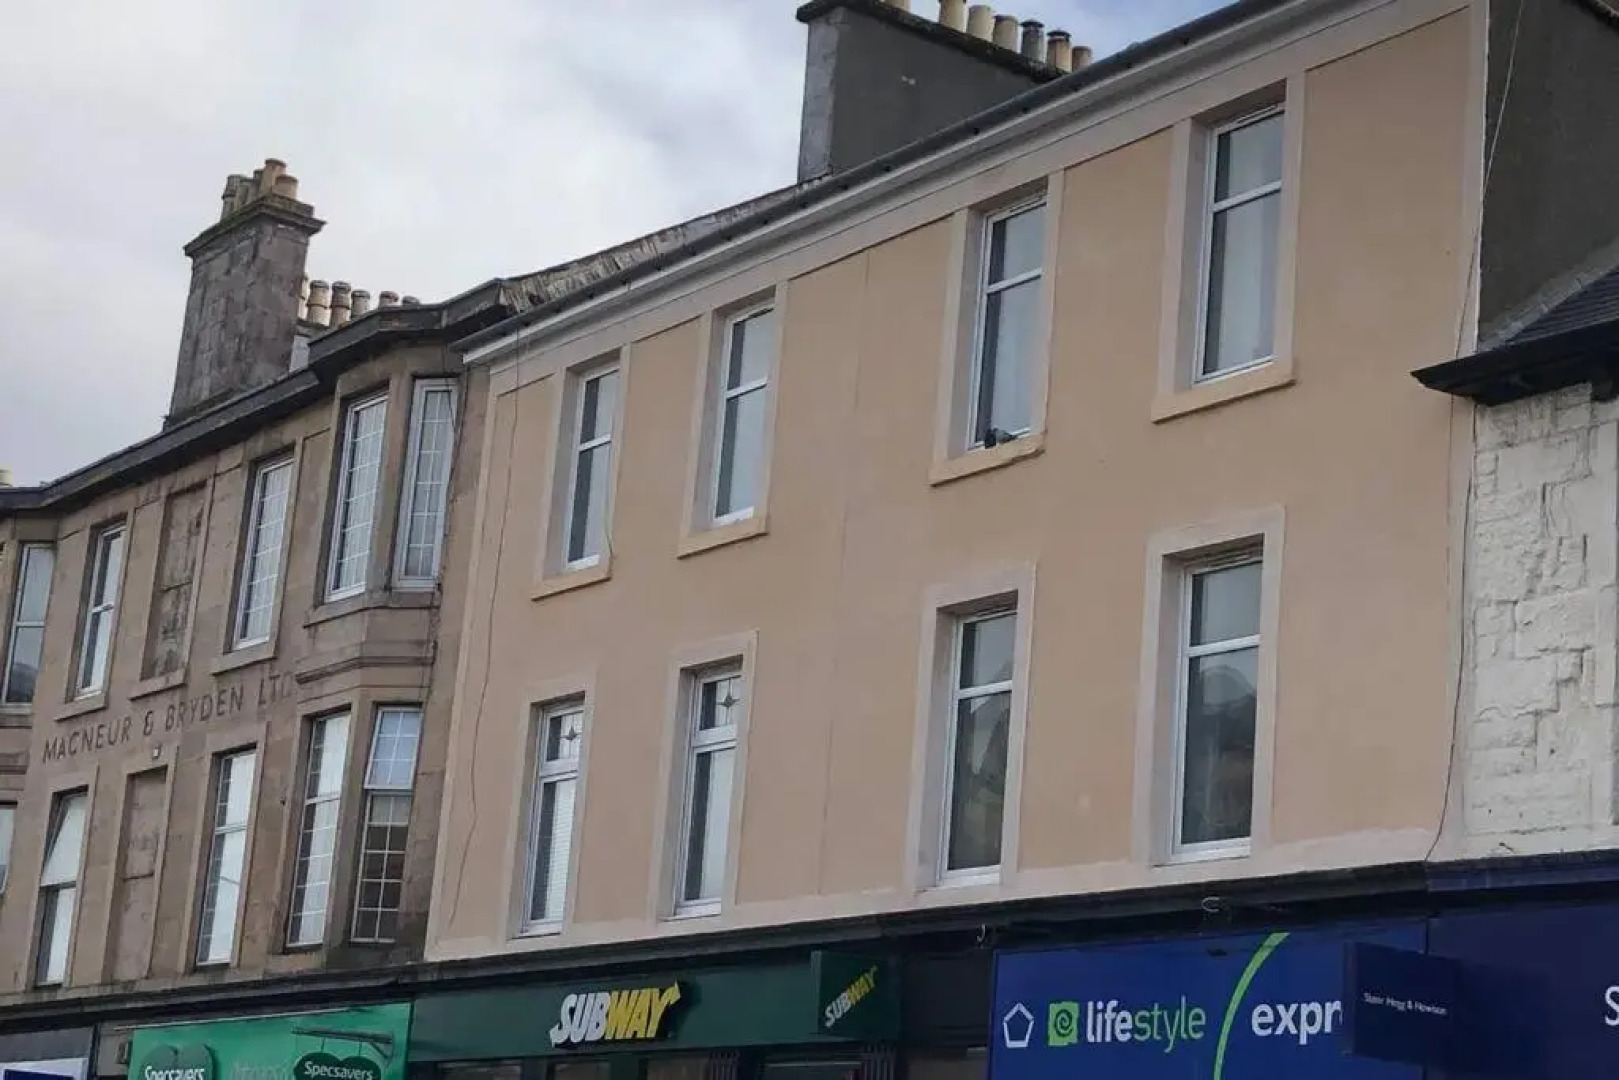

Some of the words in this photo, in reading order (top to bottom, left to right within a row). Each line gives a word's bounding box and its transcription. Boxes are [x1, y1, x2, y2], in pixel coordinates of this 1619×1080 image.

[42, 716, 132, 763] MACNEUR
[143, 711, 154, 735] &
[165, 685, 244, 731] BRYDEN
[258, 671, 294, 706] LTD
[550, 980, 681, 1048] SUBWAY
[824, 965, 879, 1028] SUBWAY
[1086, 995, 1206, 1053] lifestyle
[1251, 1000, 1343, 1045] expr
[303, 1061, 375, 1080] Specsavers
